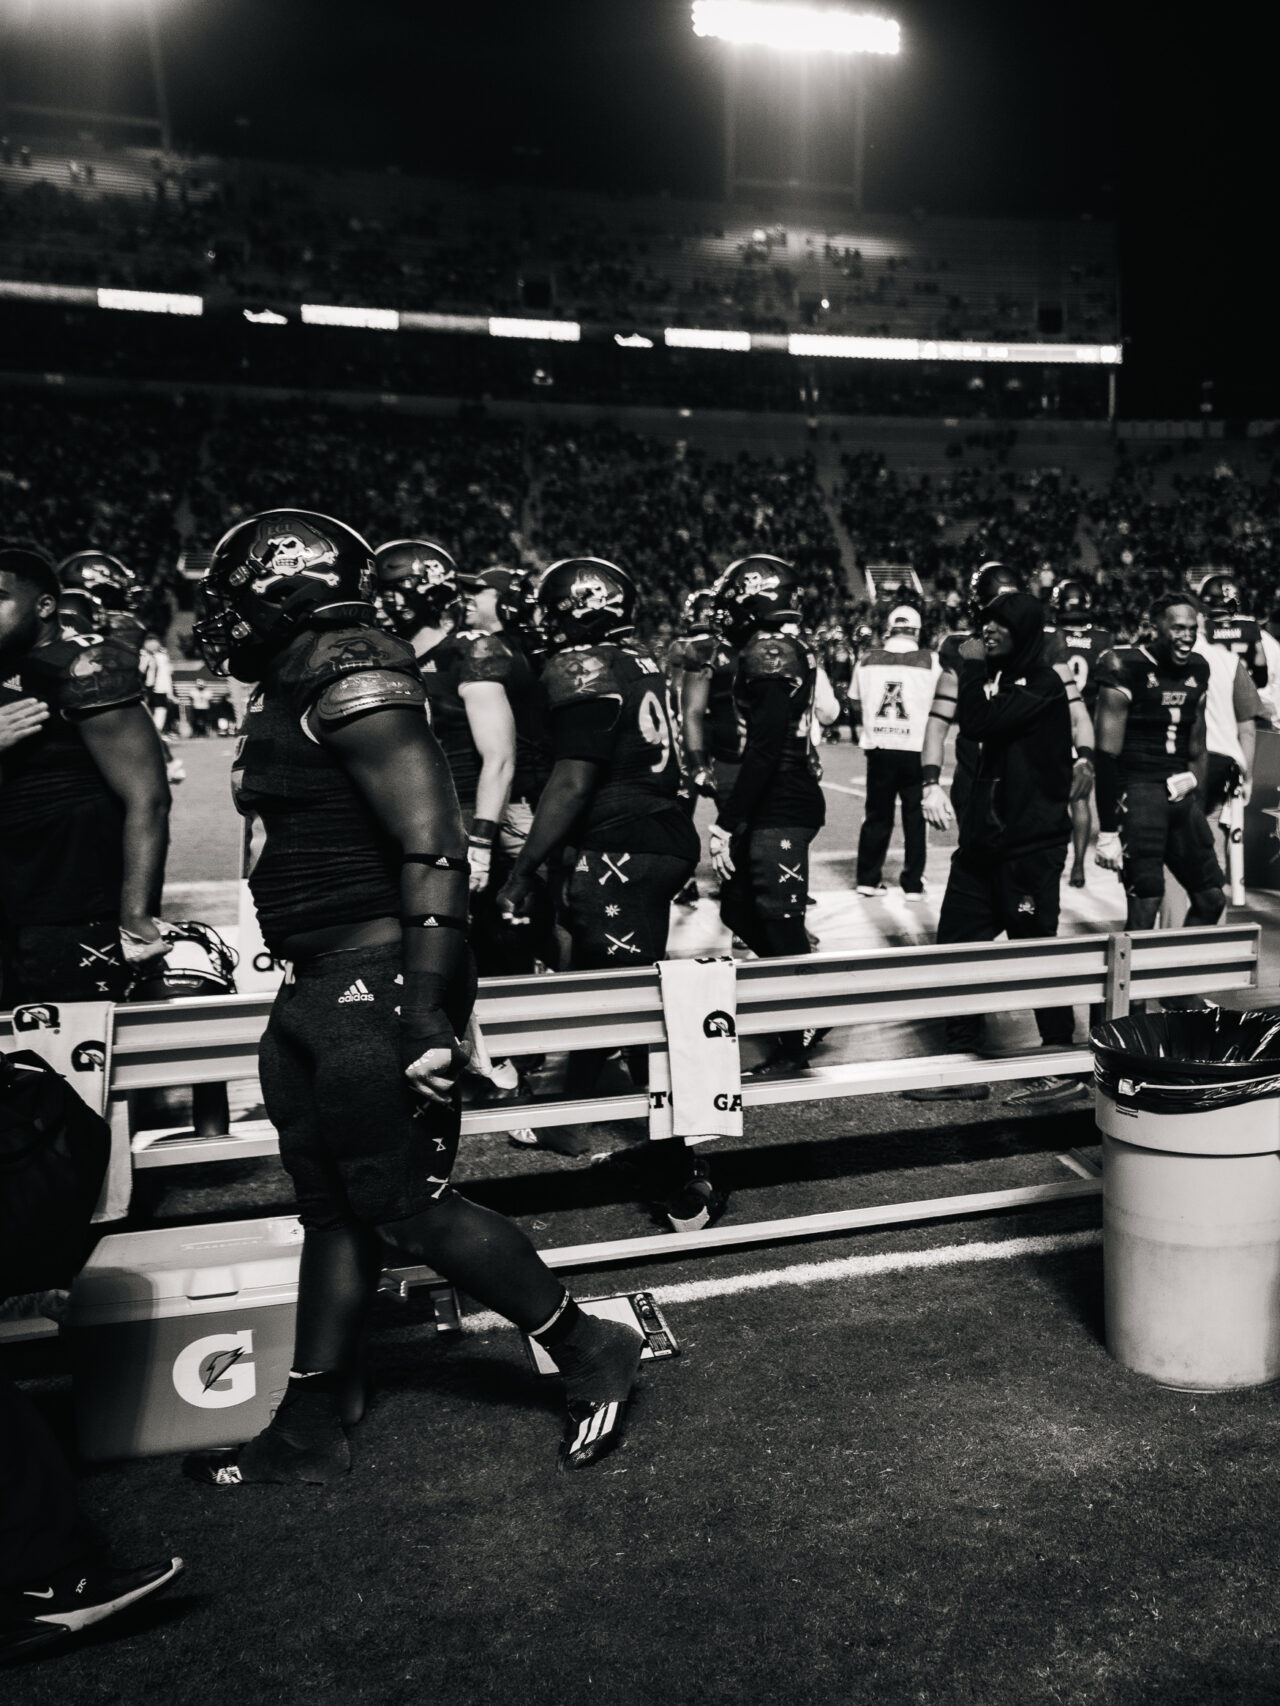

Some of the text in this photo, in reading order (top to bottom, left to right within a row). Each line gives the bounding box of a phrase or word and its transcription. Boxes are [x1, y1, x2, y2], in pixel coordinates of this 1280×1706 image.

[876, 682, 909, 720] A
[1162, 691, 1188, 706] ECU
[1166, 707, 1182, 755] 1
[338, 993, 375, 1003] adidas
[172, 1329, 256, 1409] G
